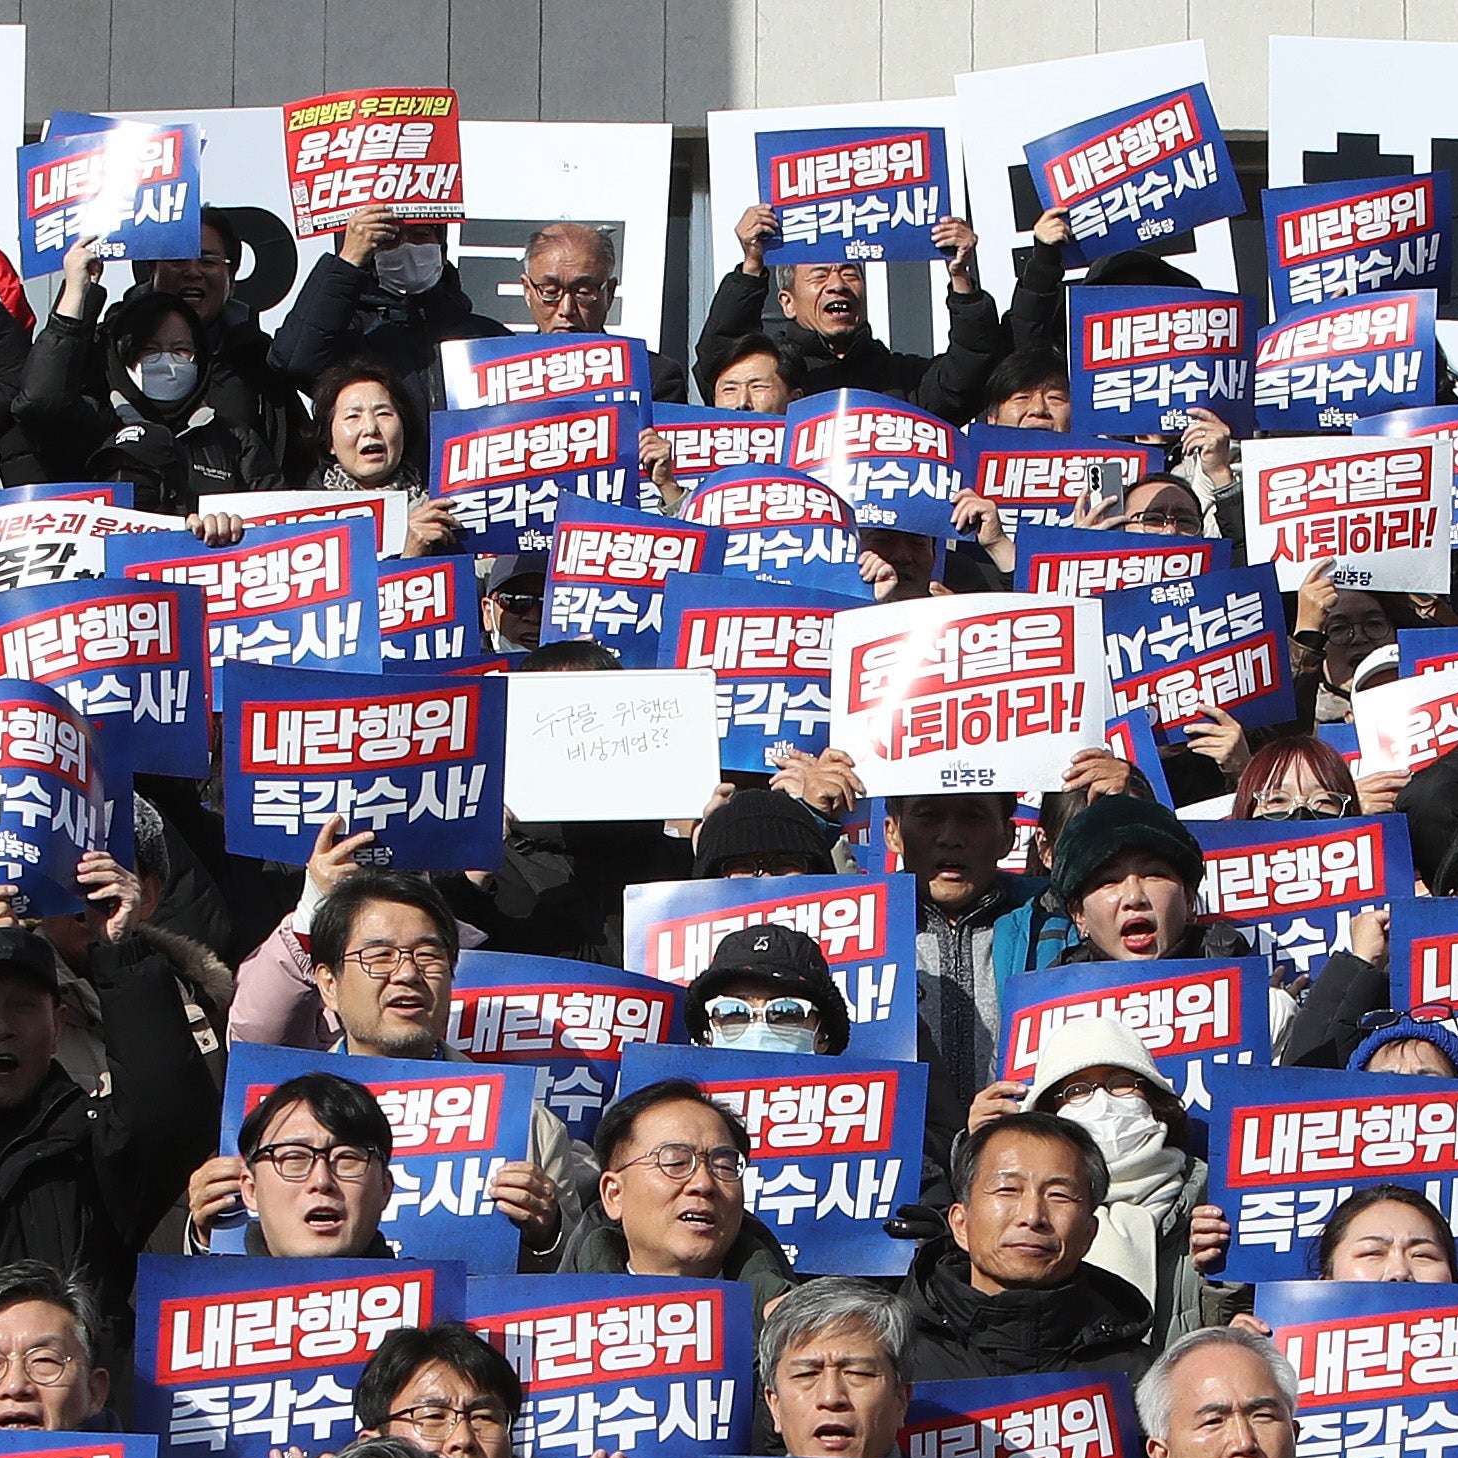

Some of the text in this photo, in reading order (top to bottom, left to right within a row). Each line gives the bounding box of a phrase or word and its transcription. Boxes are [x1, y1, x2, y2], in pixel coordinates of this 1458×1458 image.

[287, 96, 452, 132] 건희방탄 우크라개입
[296, 123, 432, 172] 윤석열을
[778, 139, 923, 191] 내란행위
[1053, 104, 1196, 201] 내란행위
[311, 164, 456, 209] 타도하자!
[1069, 144, 1217, 242] 즉각수사!
[782, 187, 938, 246] 즉각수사!
[1283, 189, 1427, 267] 내란행위
[845, 244, 883, 260] 민주당
[1092, 307, 1238, 362] 내란행위
[1258, 302, 1410, 367] 내란행위
[475, 347, 624, 406] 내란행위
[1093, 358, 1248, 411] 즉각수사!
[1254, 352, 1420, 410] 즉각수사!
[449, 415, 609, 483] 내란행위
[1267, 451, 1425, 510] 윤석열은
[1272, 512, 1436, 565] 사퇴하라!
[252, 695, 468, 768] 내란행위
[252, 765, 486, 837] 즉각수사!
[940, 767, 996, 788] 민주당
[449, 988, 665, 1053] 내란행위
[170, 1282, 422, 1375] 내란행위
